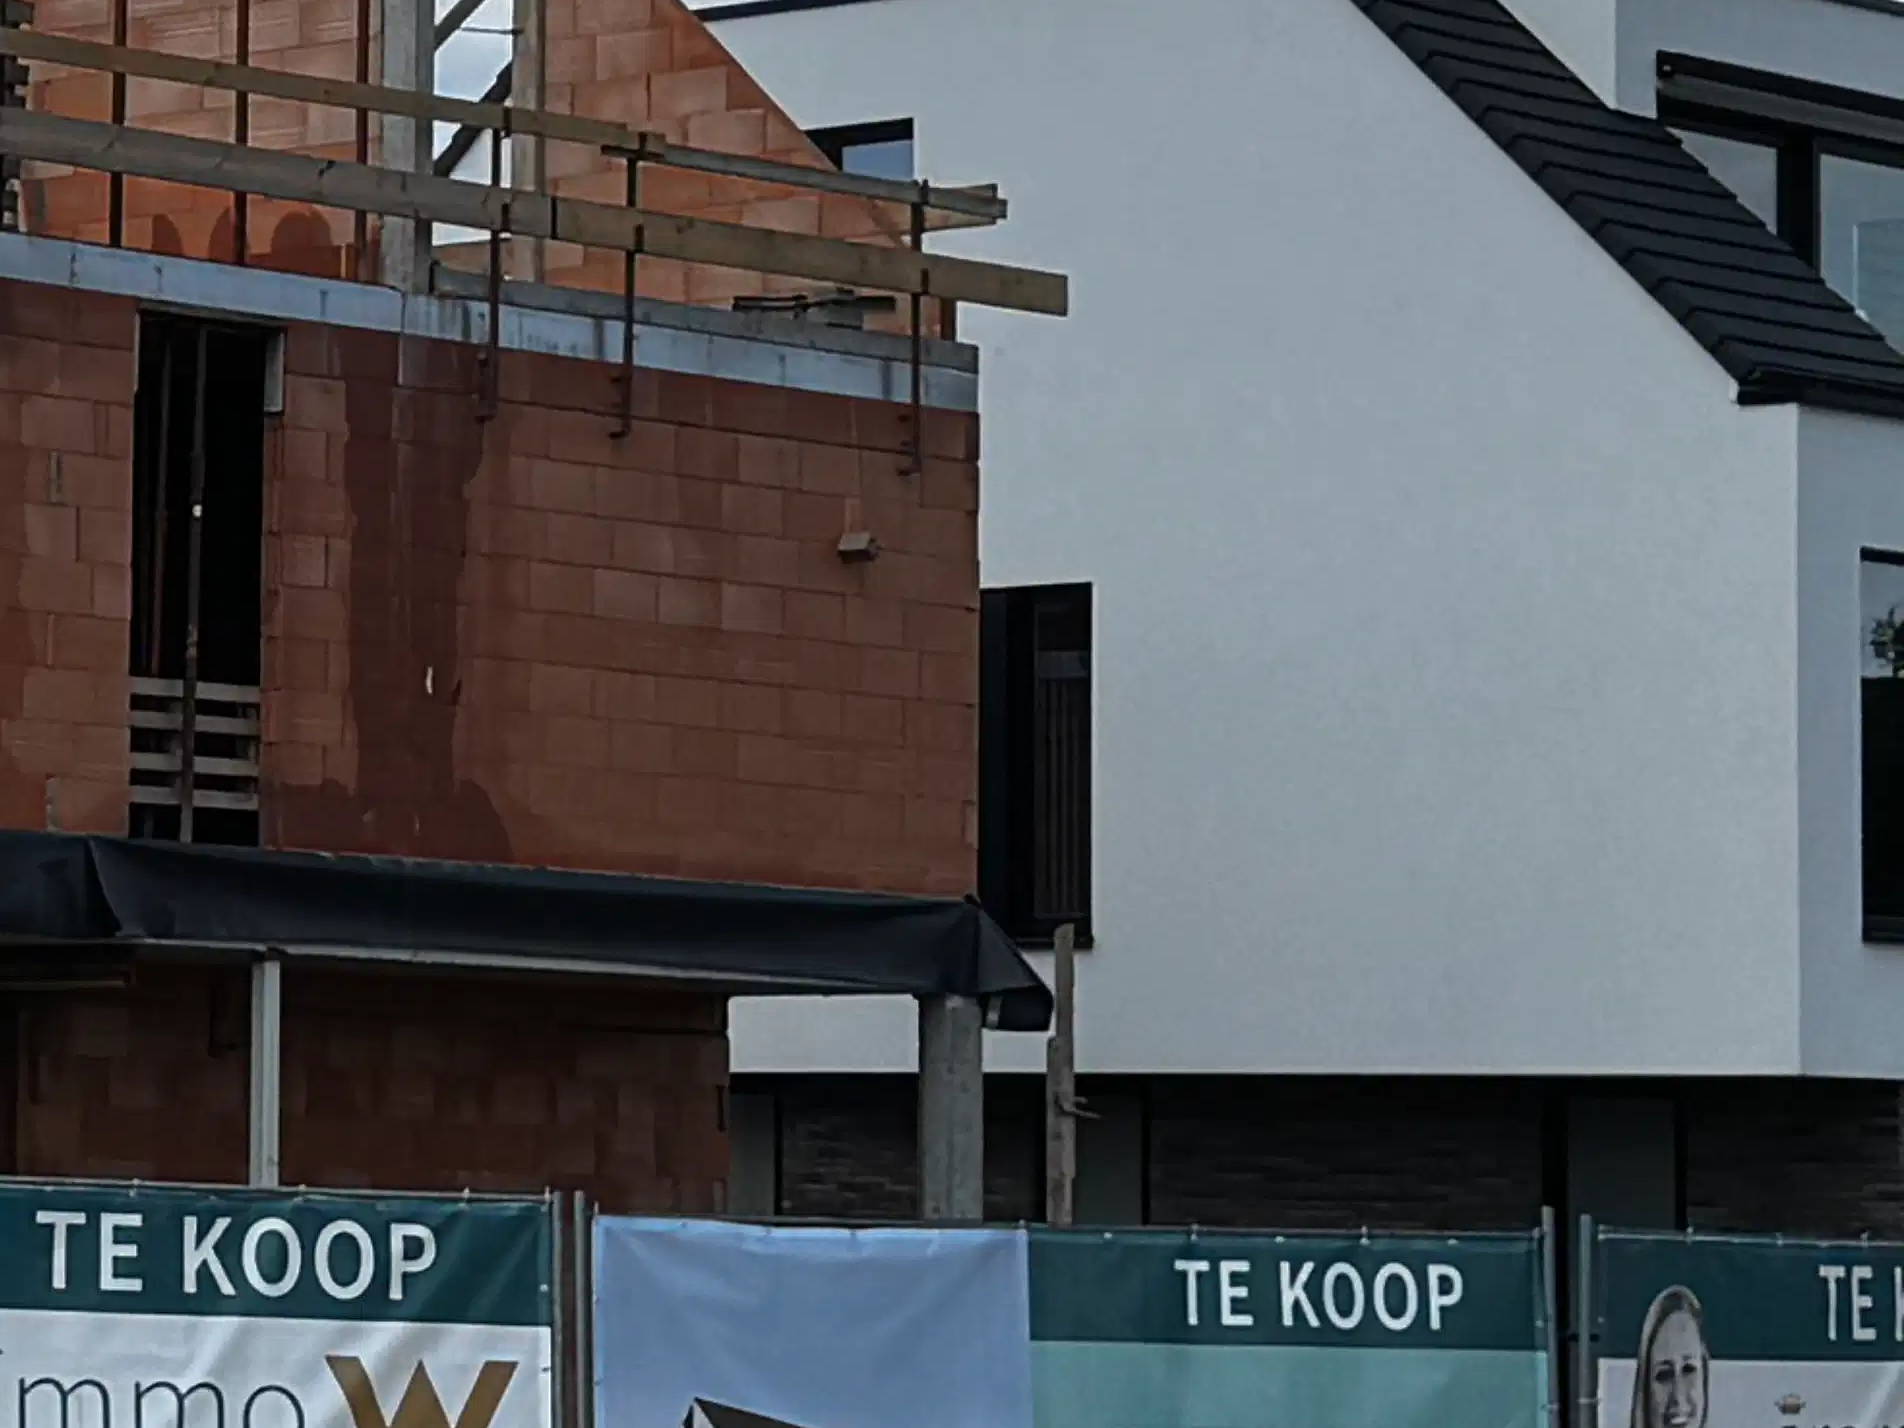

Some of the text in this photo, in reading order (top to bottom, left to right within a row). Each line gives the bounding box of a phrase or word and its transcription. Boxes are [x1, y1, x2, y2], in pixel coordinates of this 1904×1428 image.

[36, 1210, 438, 1300] TE KOOP
[1174, 1259, 1463, 1331] TE KOOP
[1818, 1264, 1878, 1342] TE
